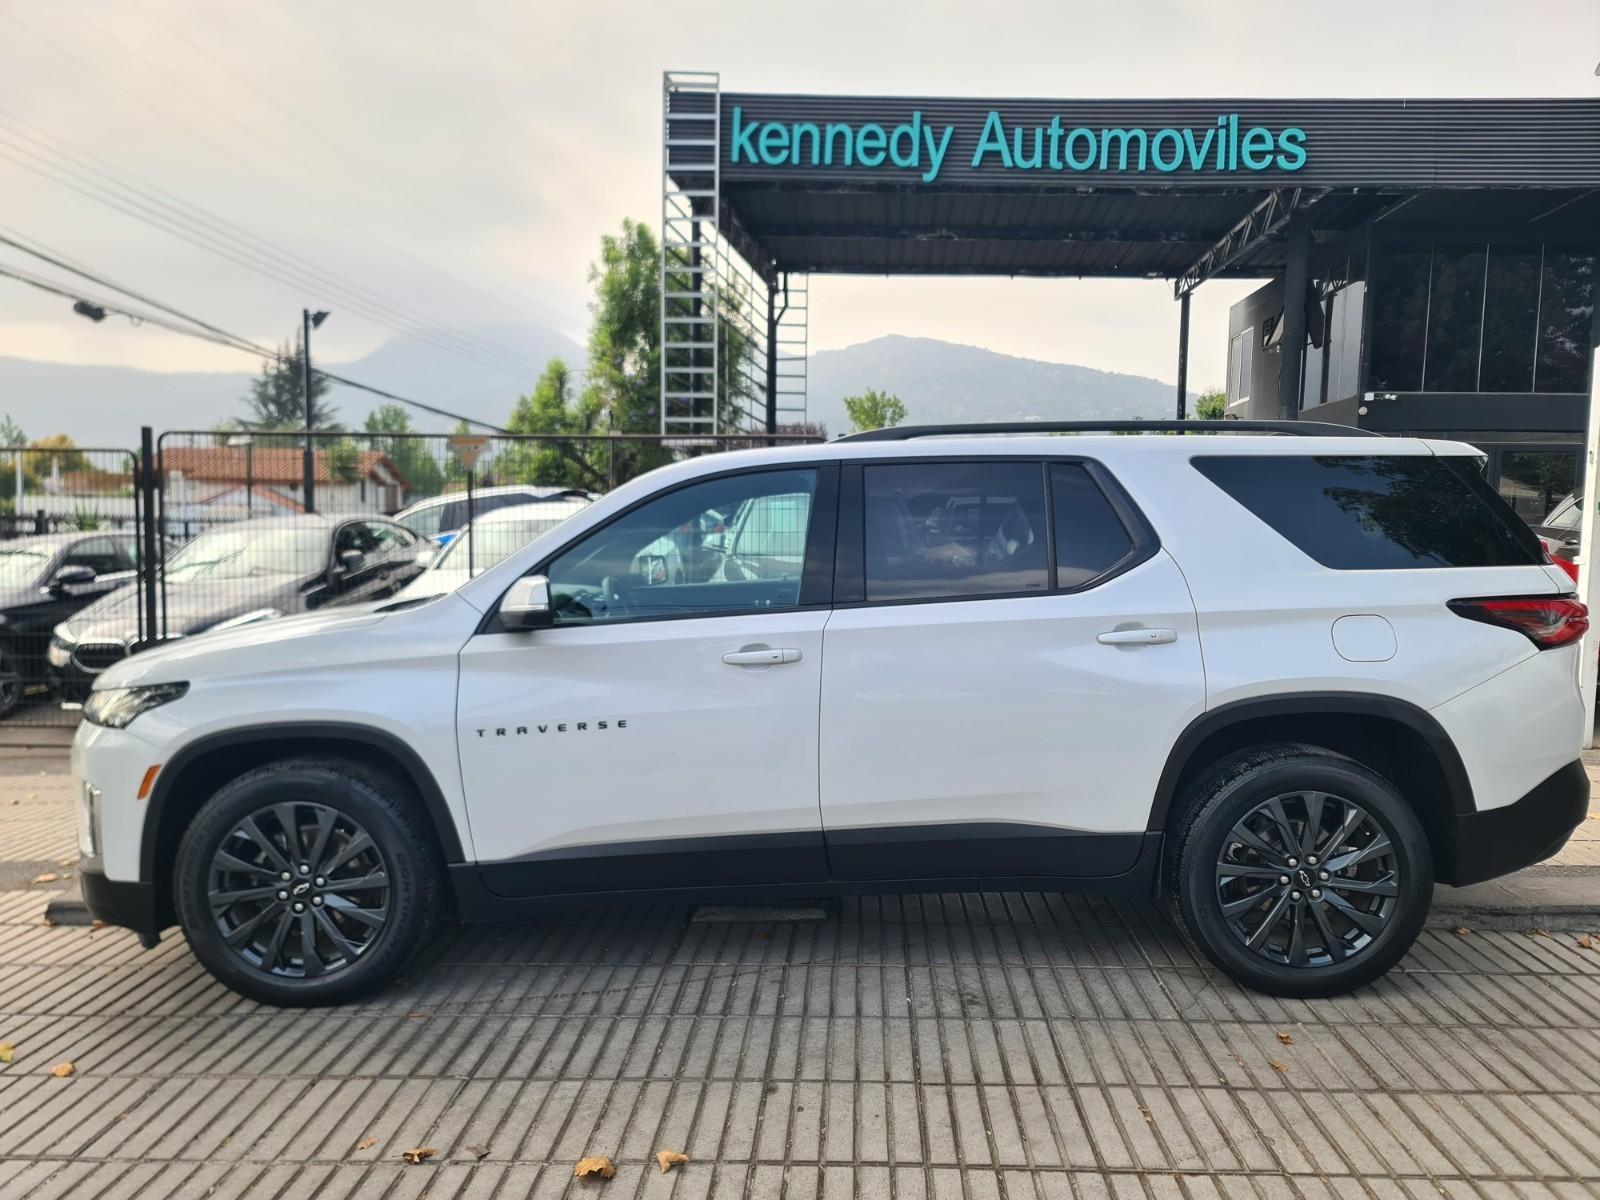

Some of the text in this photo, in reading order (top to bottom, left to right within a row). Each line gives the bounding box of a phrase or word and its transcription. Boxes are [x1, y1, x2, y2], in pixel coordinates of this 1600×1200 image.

[730, 106, 1308, 182] kennedy Automoviles
[476, 719, 627, 738] TRAVERSE
